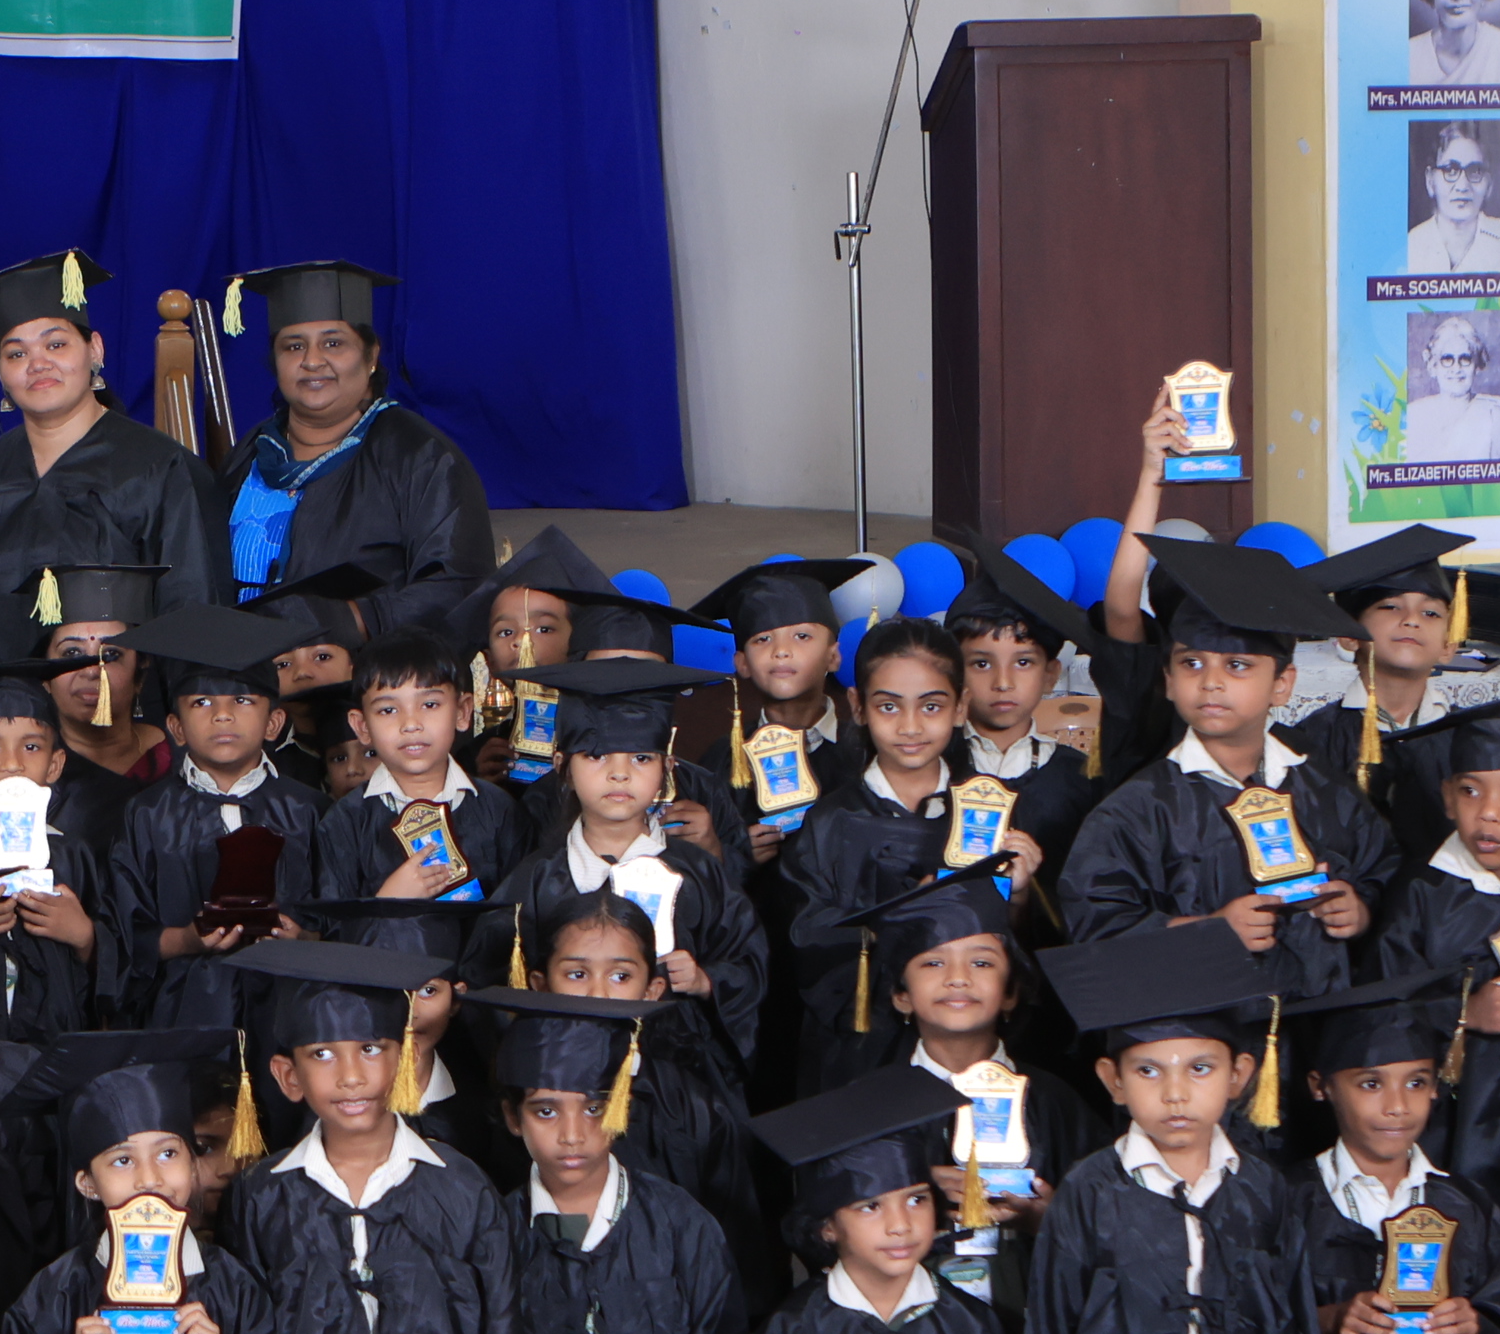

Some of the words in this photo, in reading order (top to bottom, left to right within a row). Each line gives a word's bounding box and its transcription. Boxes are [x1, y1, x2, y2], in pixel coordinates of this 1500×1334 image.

[1370, 91, 1398, 107] Mrs.
[1400, 90, 1477, 106] MARIAMMA
[1376, 281, 1406, 297] Mrs.
[1408, 279, 1485, 296] SOSAMMA
[1369, 469, 1393, 484] Mrs.
[1394, 465, 1457, 482] ELIZABETH
